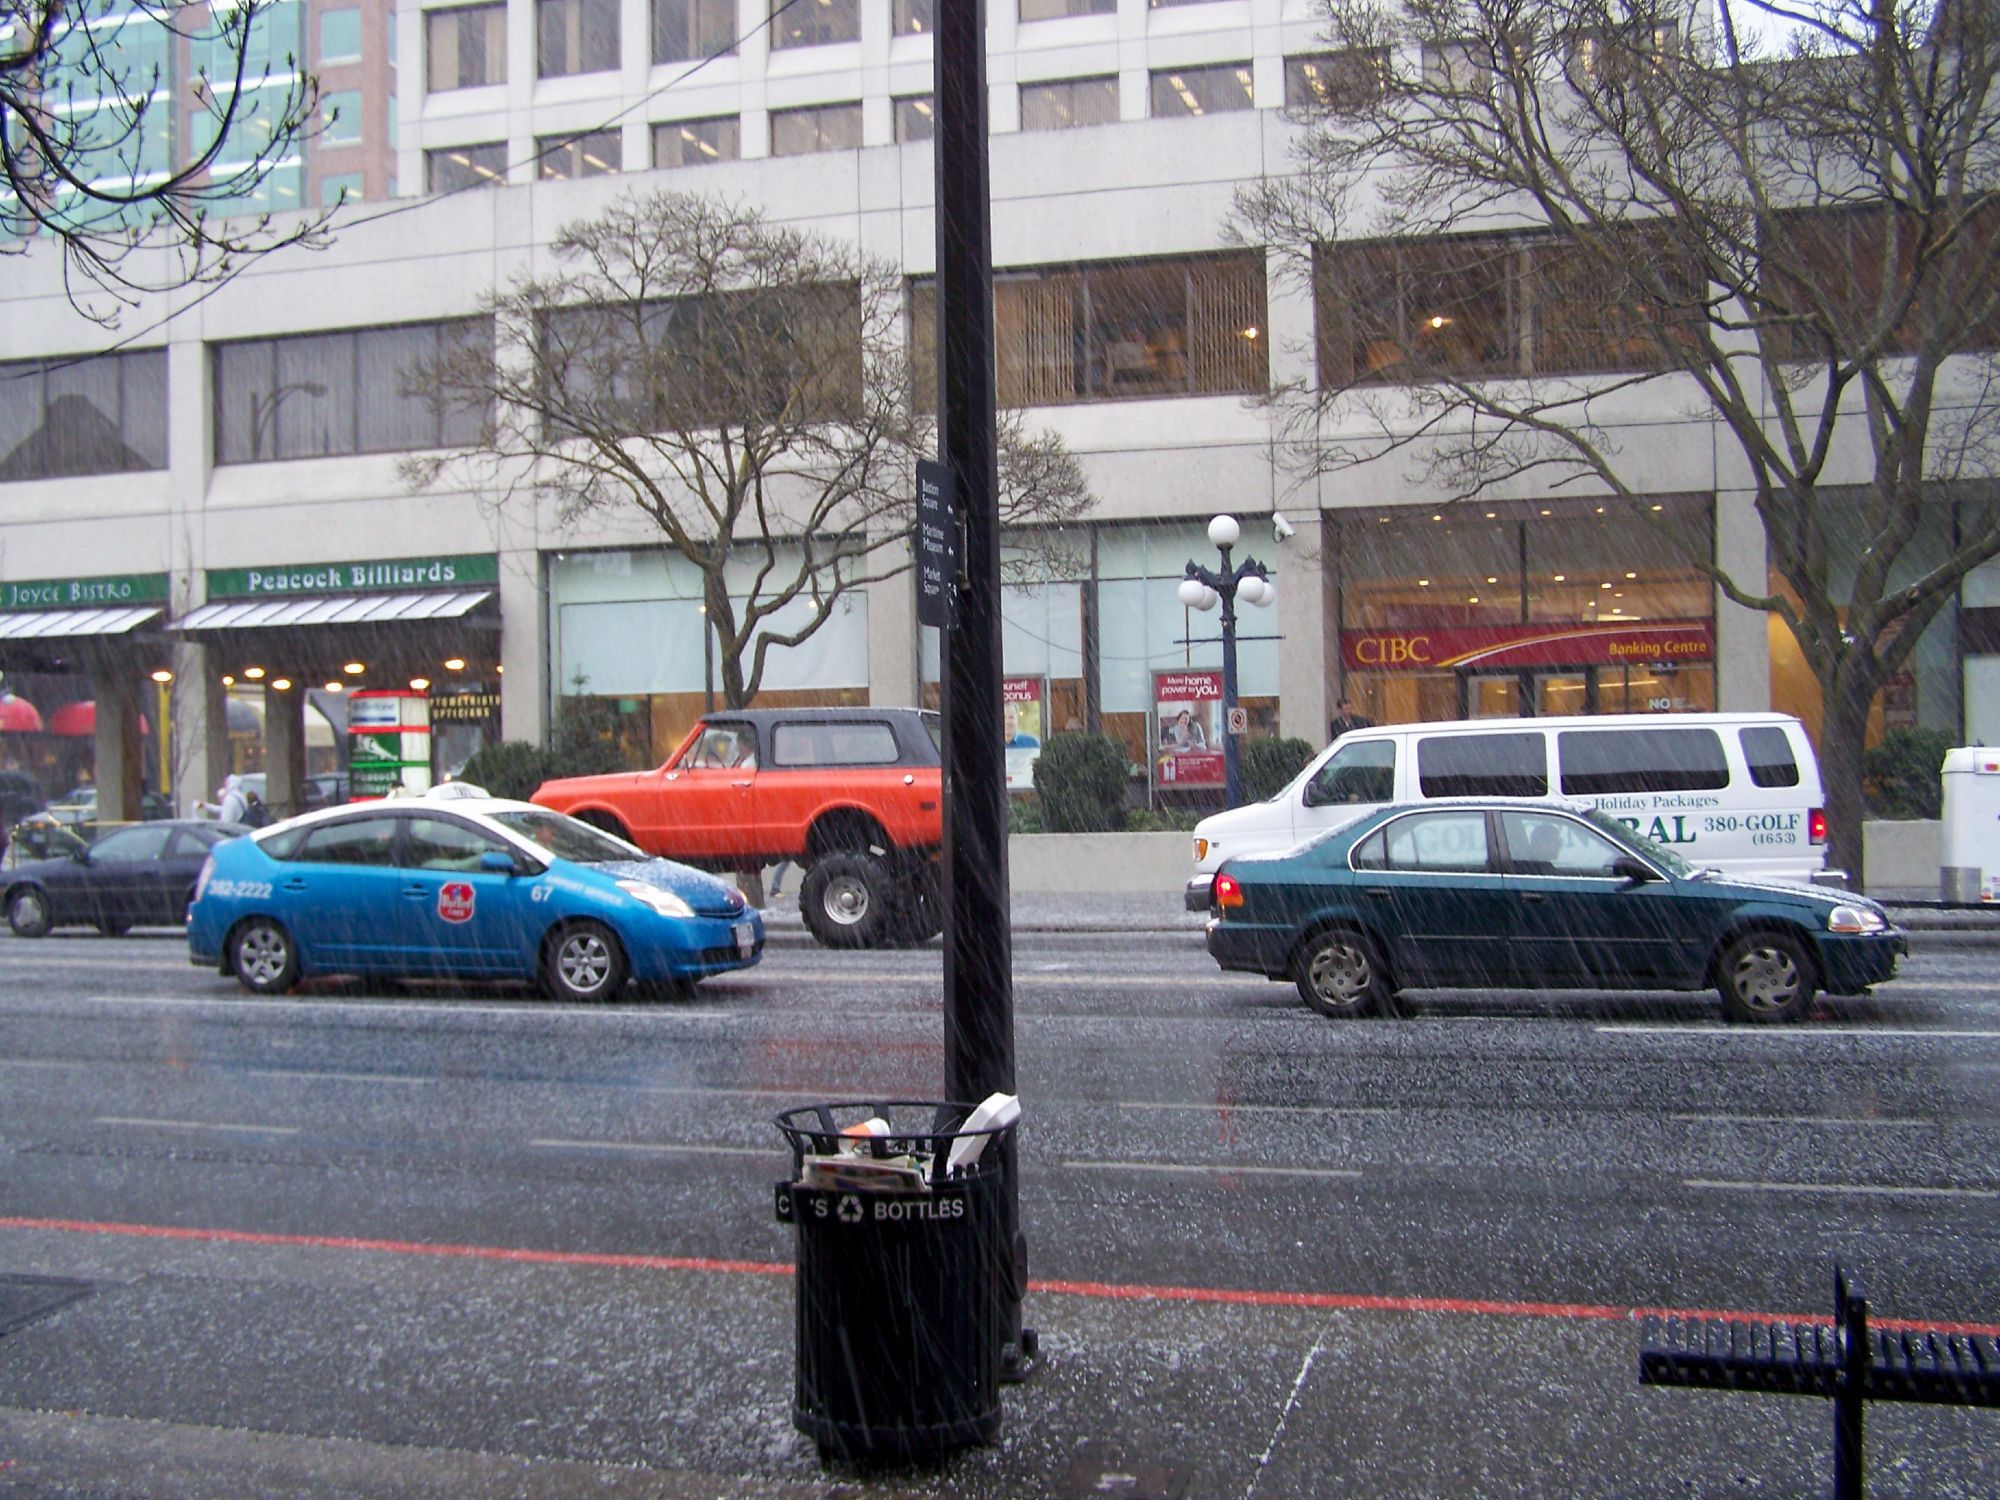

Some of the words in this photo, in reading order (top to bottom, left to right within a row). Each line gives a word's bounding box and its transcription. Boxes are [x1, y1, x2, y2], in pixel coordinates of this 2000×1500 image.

[922, 478, 939, 496] Bastion
[248, 567, 342, 591] Peacock
[351, 562, 456, 587] Billiards
[923, 565, 941, 581] Market
[1355, 636, 1430, 664] CIBC
[1609, 642, 1660, 657] Banking
[1664, 640, 1707, 653] Centre
[1184, 675, 1212, 686] home
[1161, 687, 1187, 697] power
[1648, 698, 1671, 710] NO
[1594, 797, 1648, 812] Holiday
[1652, 792, 1719, 808] Packages
[1704, 815, 1800, 832] 380-GOLF
[1752, 833, 1796, 845] (4653)
[531, 885, 553, 902] 67
[874, 1199, 963, 1220] BOTTLES
